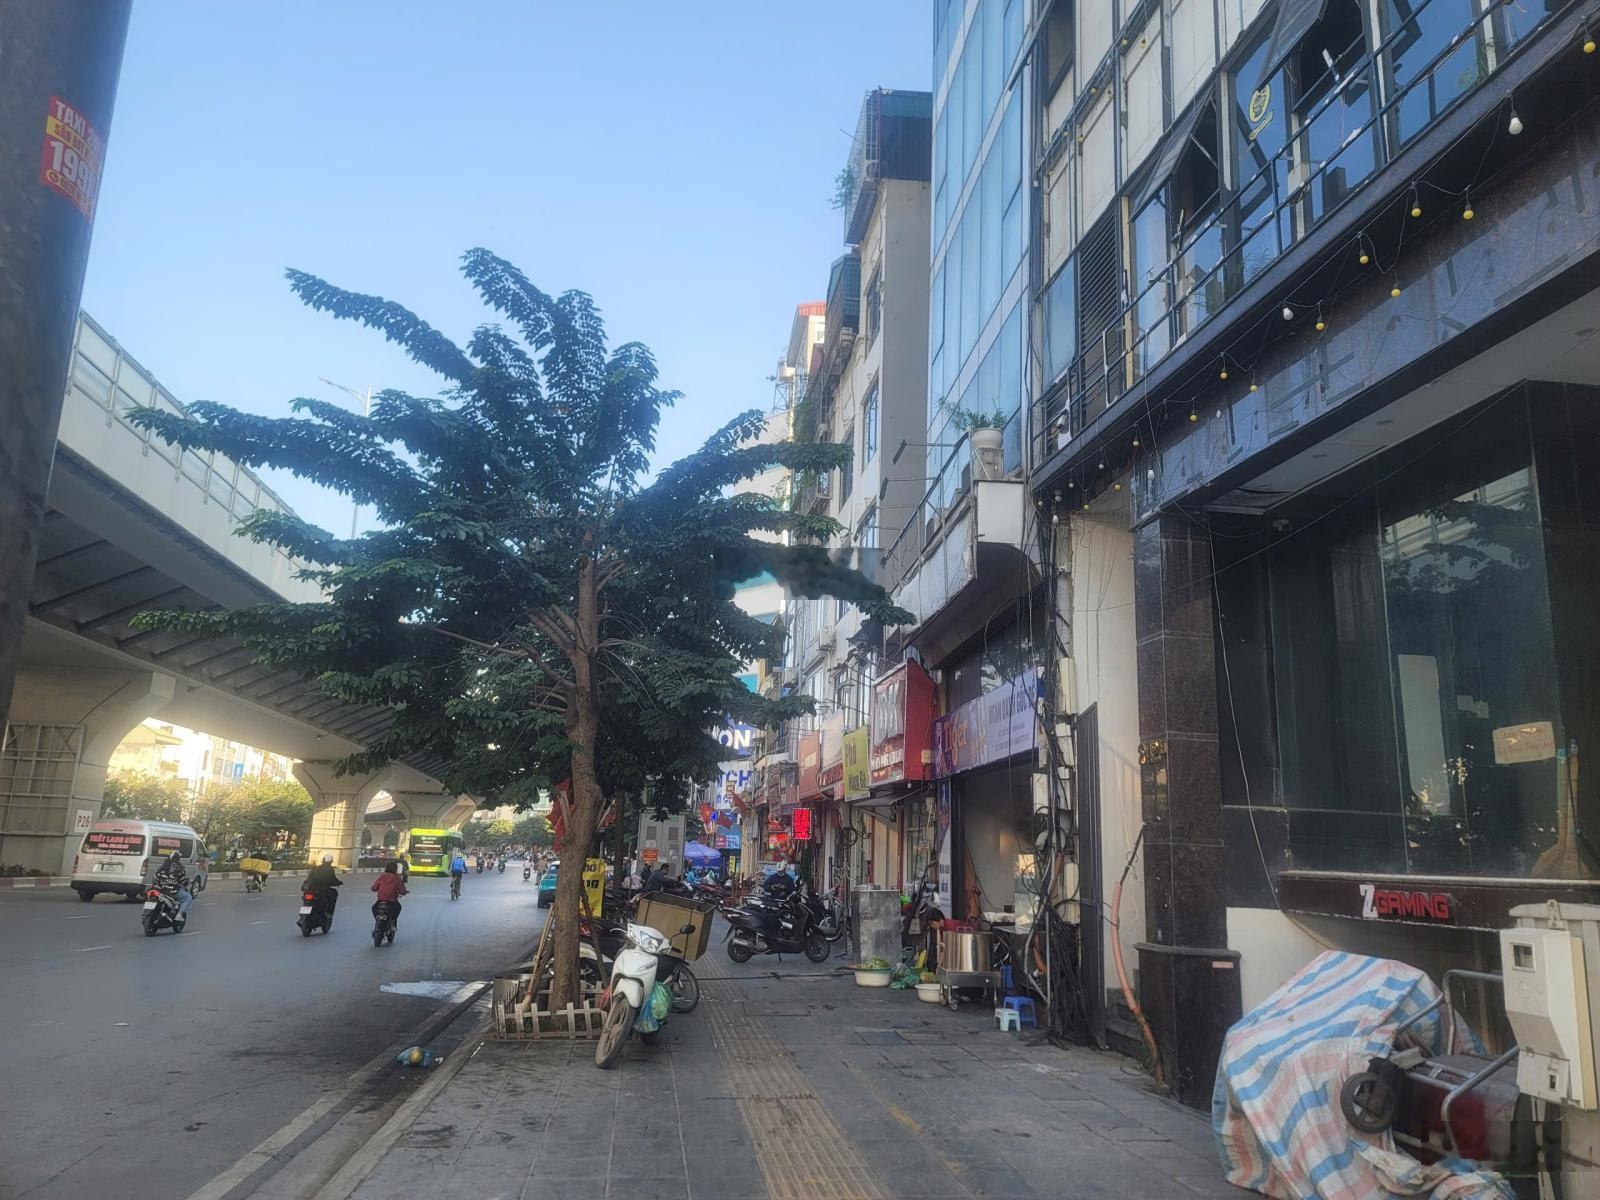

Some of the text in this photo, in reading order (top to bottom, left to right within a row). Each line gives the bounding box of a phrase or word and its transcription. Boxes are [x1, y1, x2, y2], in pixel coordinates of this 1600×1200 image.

[56, 100, 86, 138] TAXI
[943, 717, 969, 766] Tiger
[77, 815, 90, 828] P26
